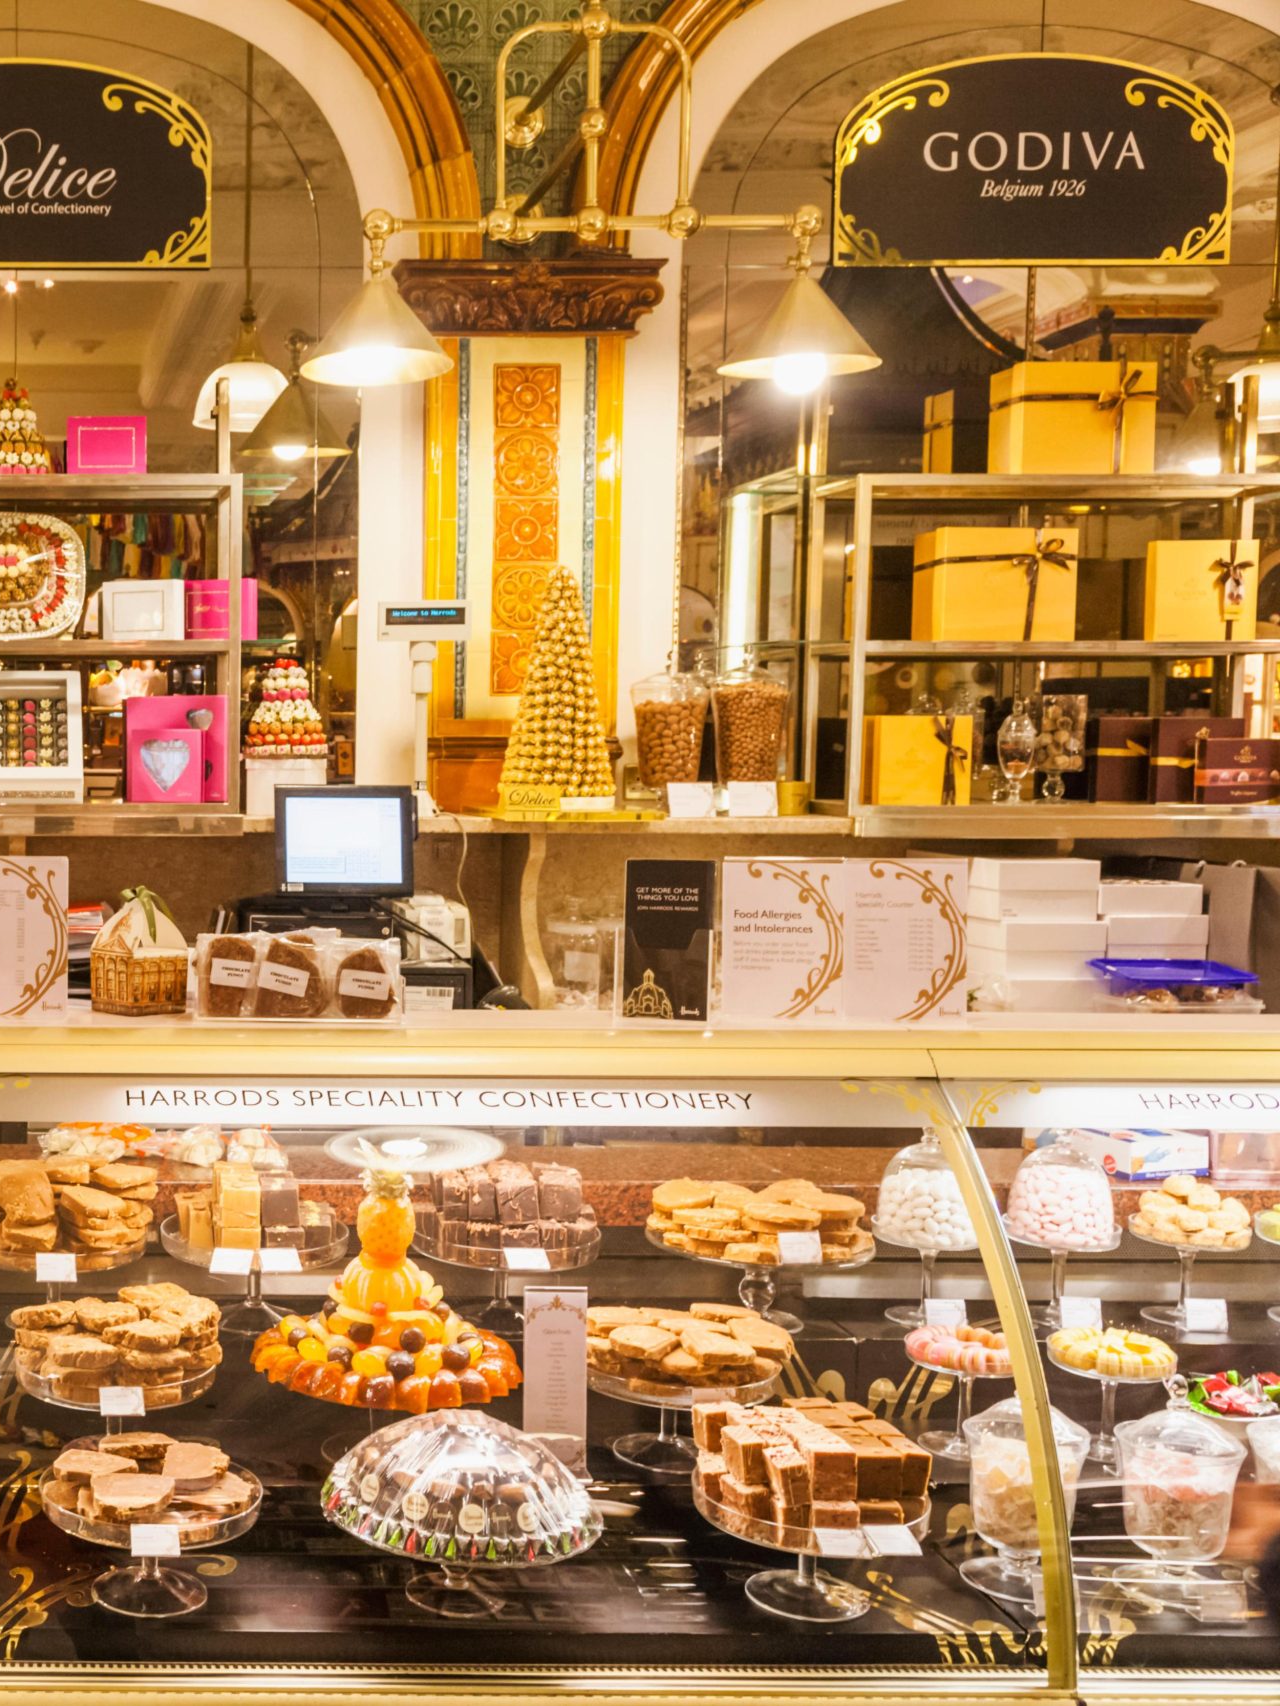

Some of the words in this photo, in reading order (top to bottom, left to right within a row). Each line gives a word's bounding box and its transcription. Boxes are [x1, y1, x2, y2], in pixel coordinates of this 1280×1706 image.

[923, 131, 1145, 172] GODIVA
[980, 179, 1044, 201] Belgium
[1049, 178, 1087, 197] 1926
[17, 202, 30, 214] of
[31, 202, 111, 217] Confectionery
[508, 788, 556, 807] Delice
[636, 886, 649, 894] GET
[733, 909, 758, 919] Food
[761, 909, 802, 921] Allergies
[733, 923, 751, 933] and
[754, 923, 813, 934] Intolerances
[125, 1089, 280, 1106] HARRODS
[292, 1090, 463, 1108] SPECIALITY
[478, 1091, 753, 1110] CONFECTIONERY
